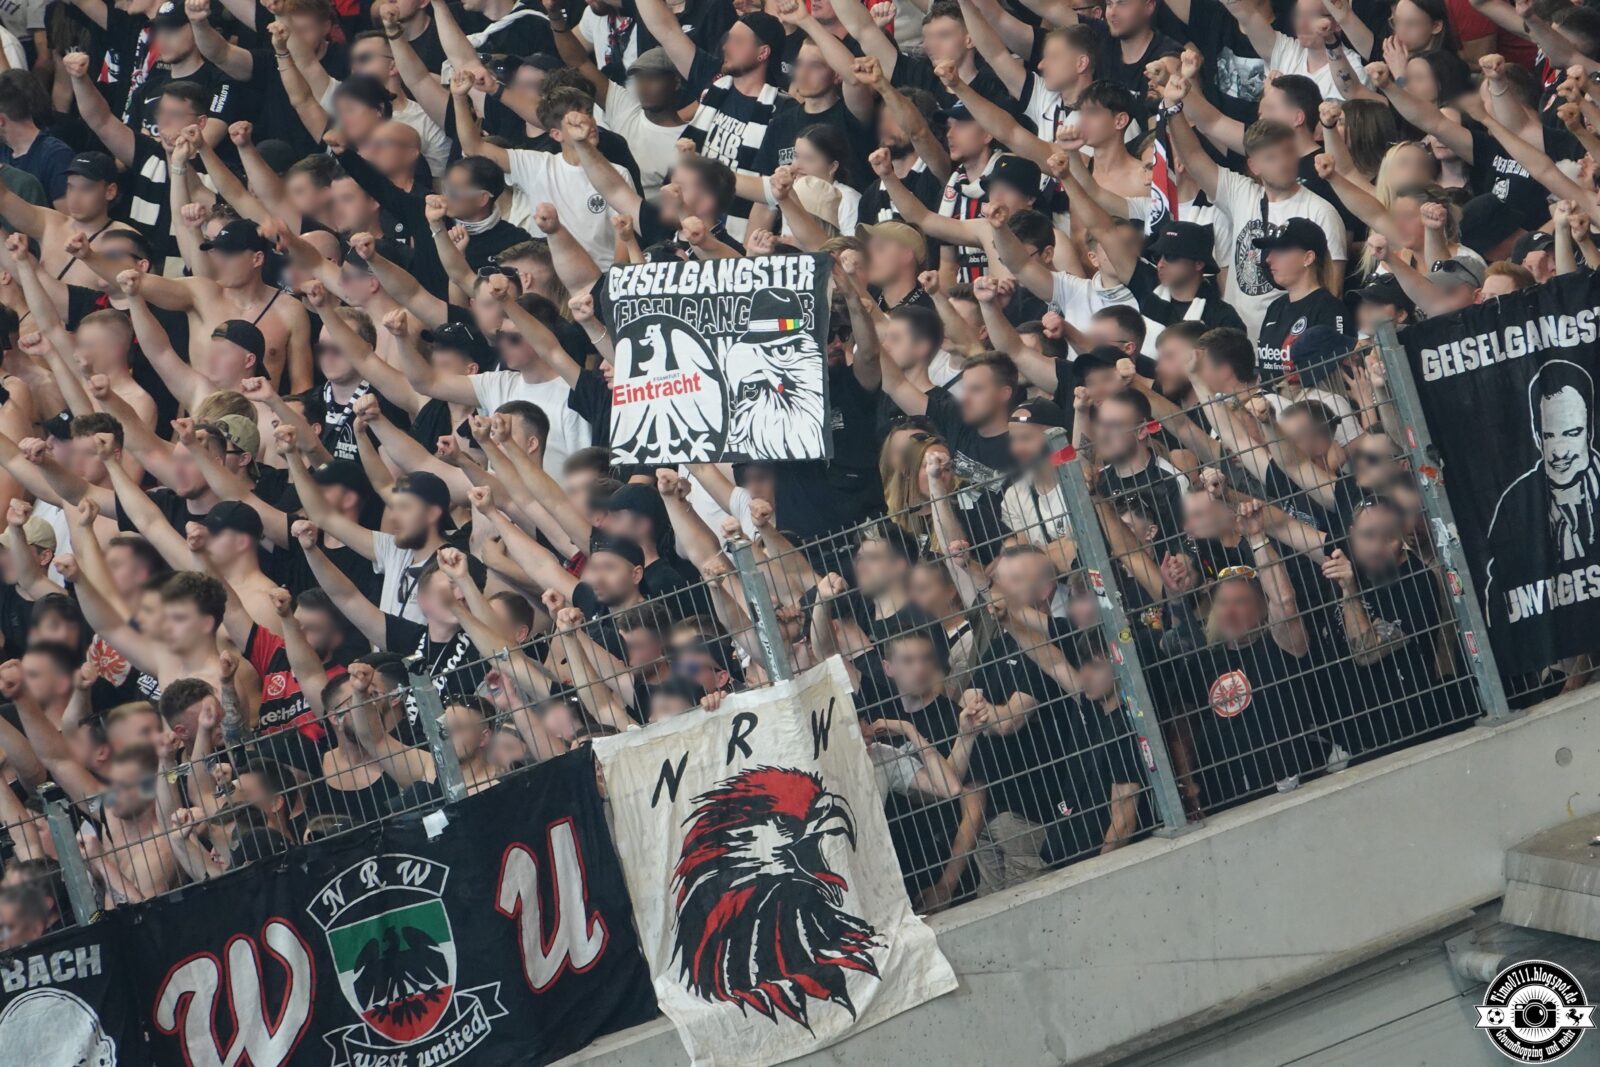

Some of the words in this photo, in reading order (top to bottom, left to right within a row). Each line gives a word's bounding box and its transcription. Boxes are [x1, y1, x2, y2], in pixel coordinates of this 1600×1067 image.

[609, 255, 815, 301] GEISELGANGSTER
[612, 372, 702, 406] Eintracht
[495, 816, 610, 994] U
[153, 916, 316, 1067] W
[353, 1050, 409, 1067] west
[416, 1004, 487, 1067] united
